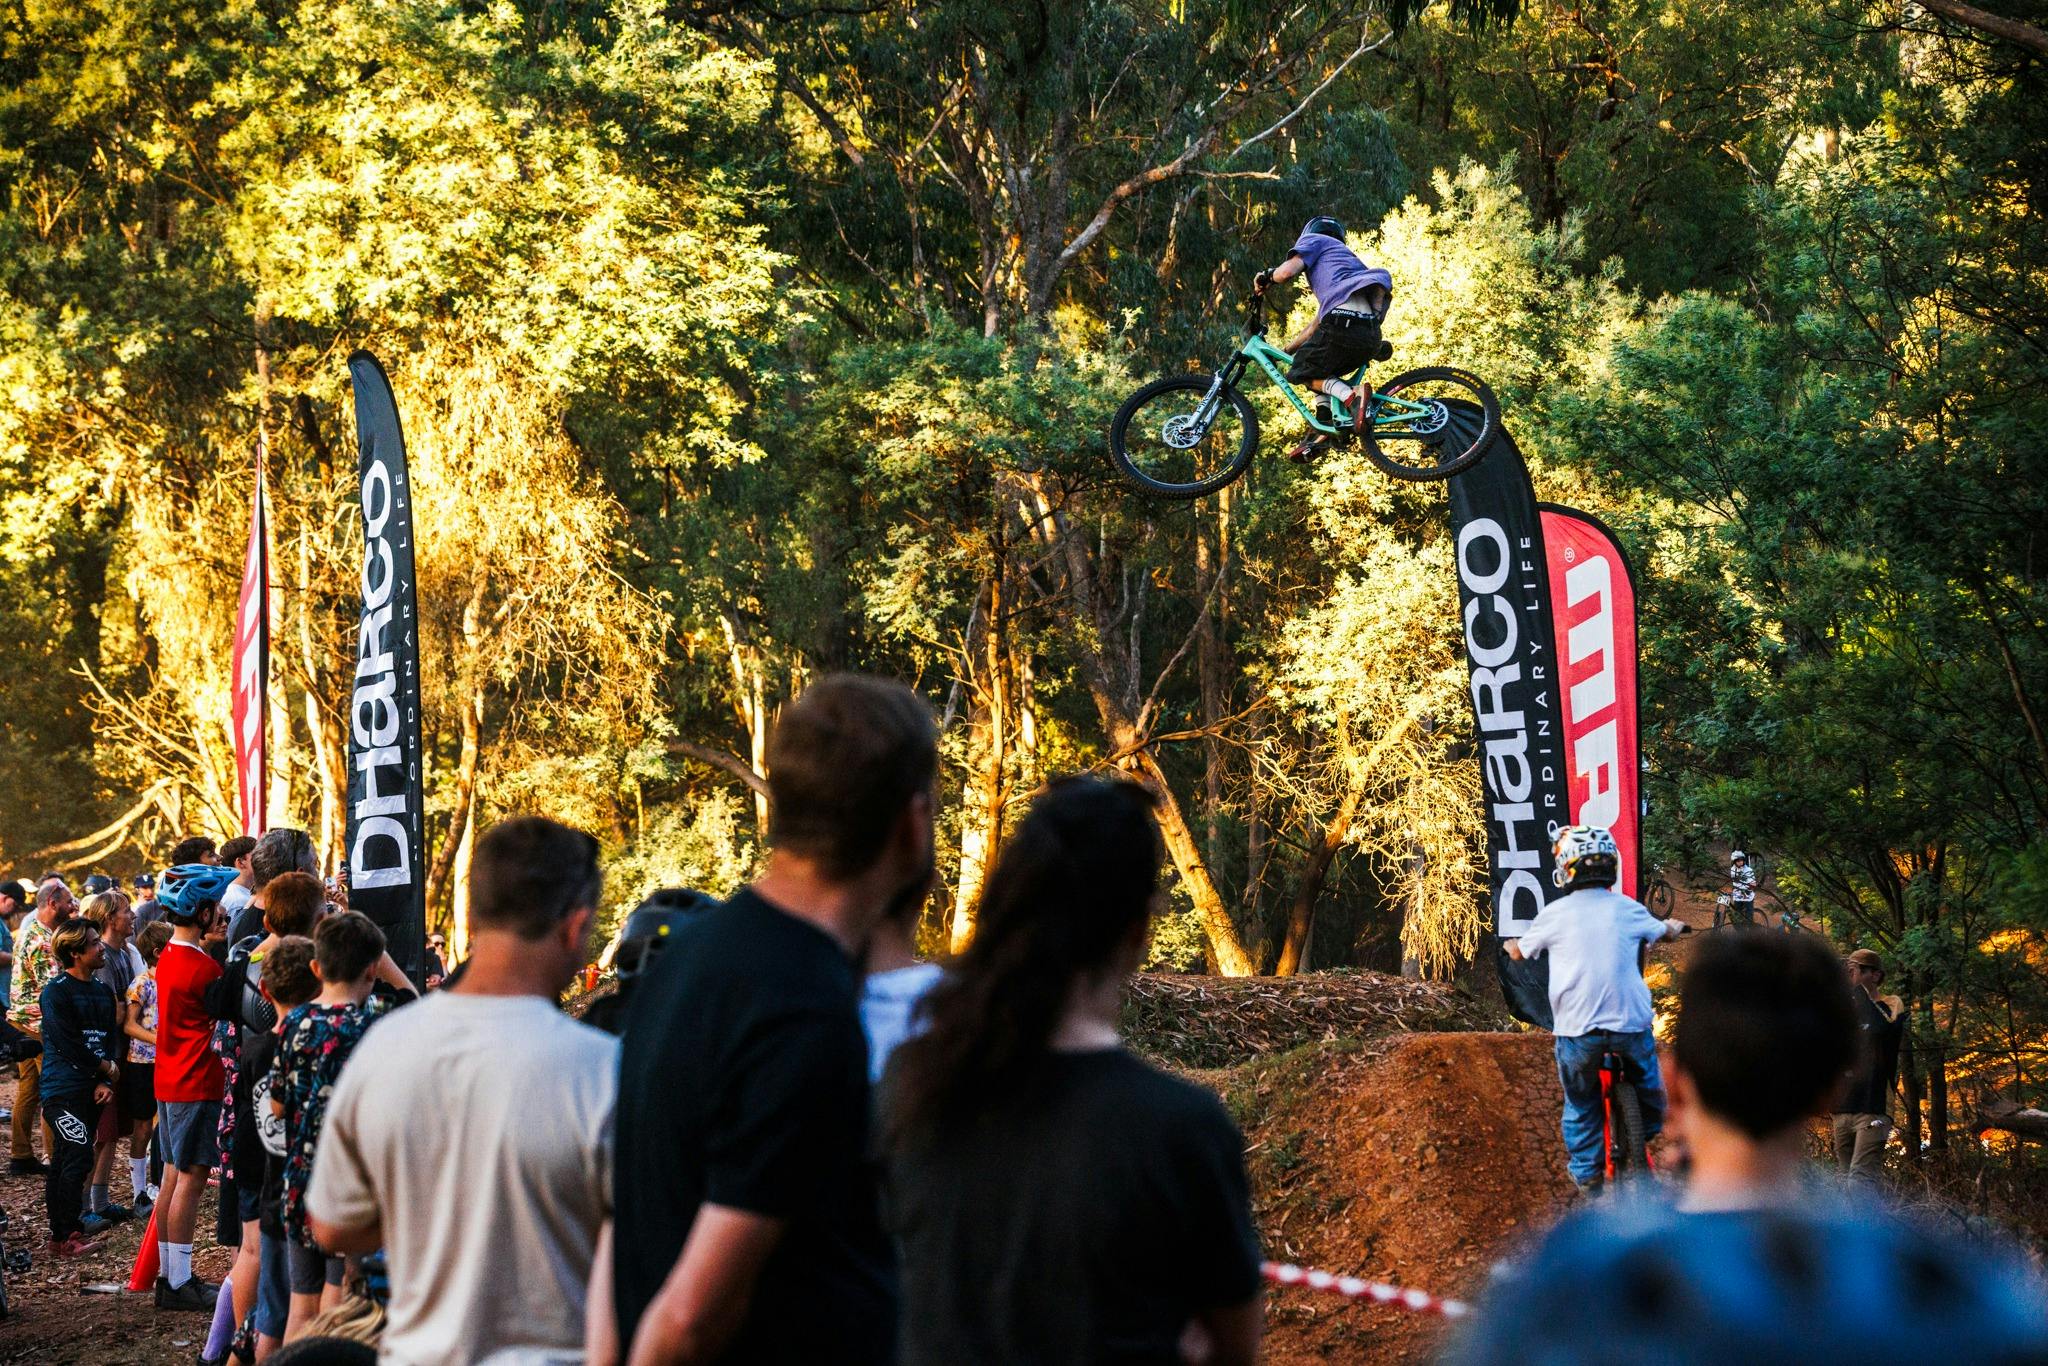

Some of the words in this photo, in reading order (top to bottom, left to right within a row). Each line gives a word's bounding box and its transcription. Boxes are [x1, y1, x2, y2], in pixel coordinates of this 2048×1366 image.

[395, 473, 407, 548] LIFE
[1520, 537, 1539, 611] LIFE
[400, 580, 416, 781] ORDINARY
[1529, 640, 1558, 838] ORDINARY
